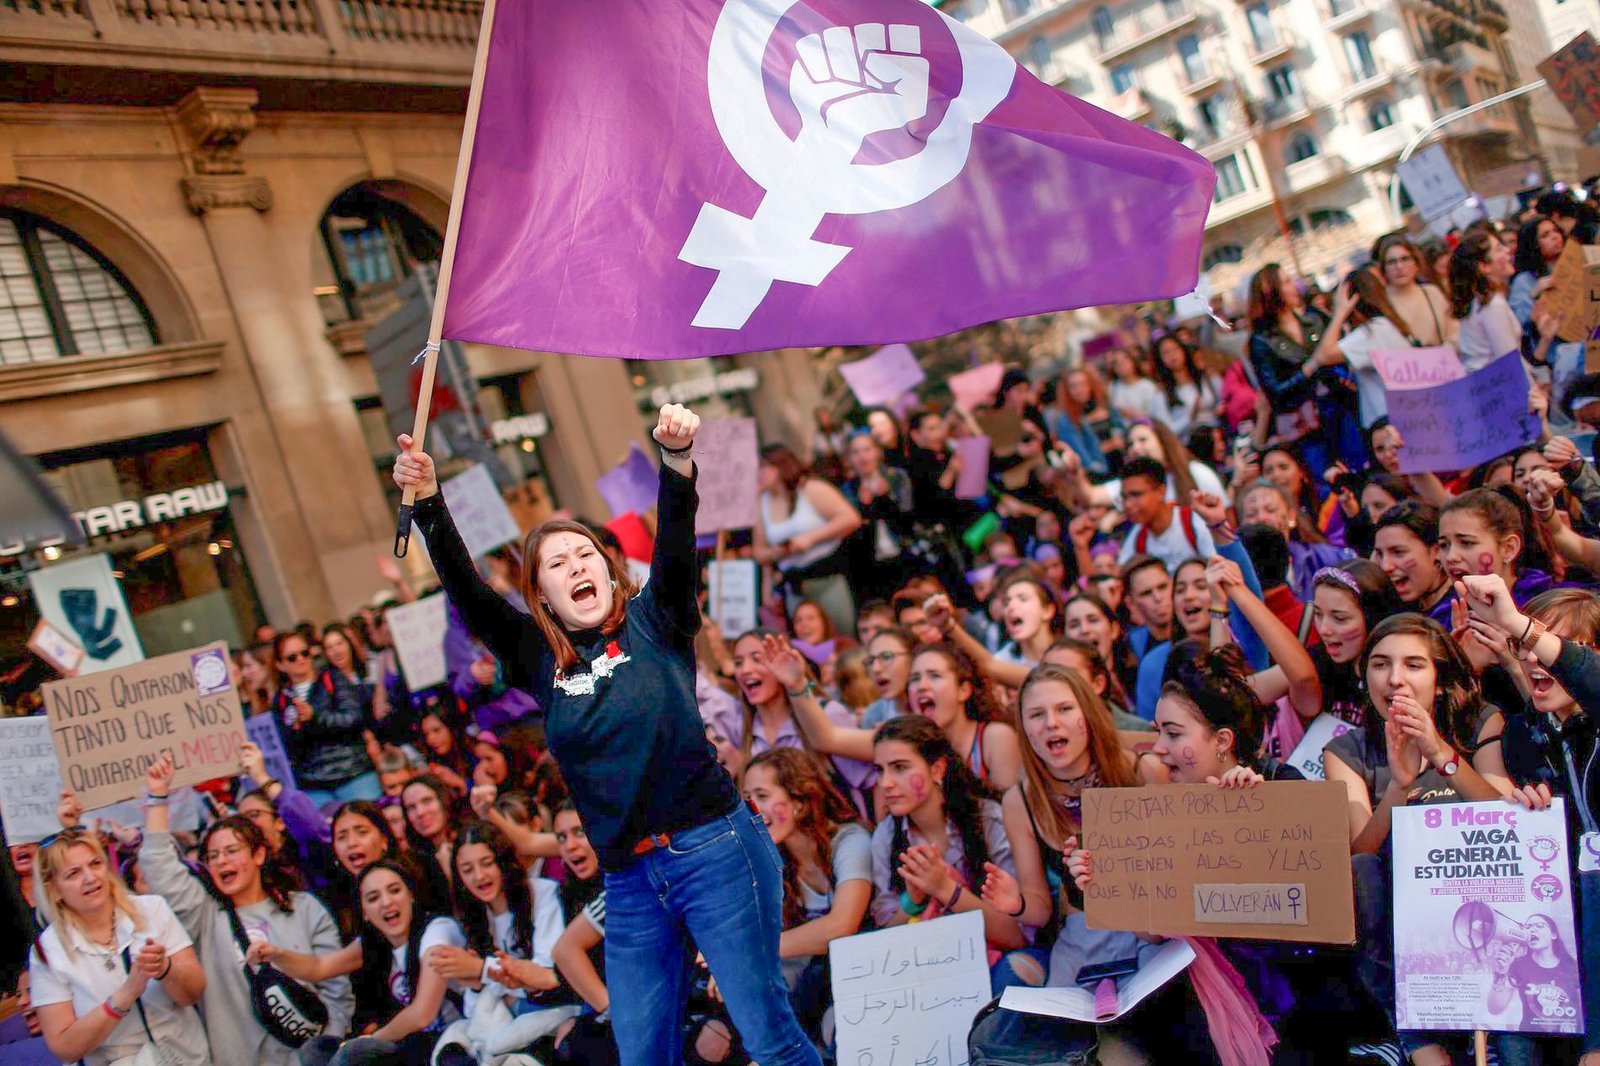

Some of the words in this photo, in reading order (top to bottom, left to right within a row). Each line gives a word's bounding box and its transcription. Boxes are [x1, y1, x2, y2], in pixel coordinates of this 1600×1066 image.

[145, 481, 229, 524] RAW
[53, 687, 100, 721] NOS
[111, 669, 195, 709] QUITARON
[54, 718, 126, 757] TANTO
[134, 710, 175, 740] QUE
[184, 699, 232, 730] NOS
[69, 754, 157, 792] QUITARON
[182, 731, 244, 768] MIEDO
[1091, 794, 1104, 825] Y
[1109, 796, 1175, 825] GRITAR
[1181, 791, 1219, 816] POR
[1225, 792, 1265, 814] LAS
[1424, 808, 1442, 828] 8
[1451, 806, 1518, 829] Març
[1234, 828, 1270, 844] QUE
[1280, 823, 1313, 843] AÚN
[1460, 828, 1520, 845] VAGA
[1091, 858, 1114, 874] NO
[1117, 856, 1174, 872] TIENEN
[1196, 854, 1242, 870] ALAS
[1427, 845, 1522, 864] GENERAL
[1414, 863, 1524, 879] ESTUDIANTIL
[1087, 884, 1120, 900] QUE
[1127, 881, 1149, 900] YA
[1156, 884, 1178, 900] NO
[1198, 889, 1281, 914] VOLVERÁN
